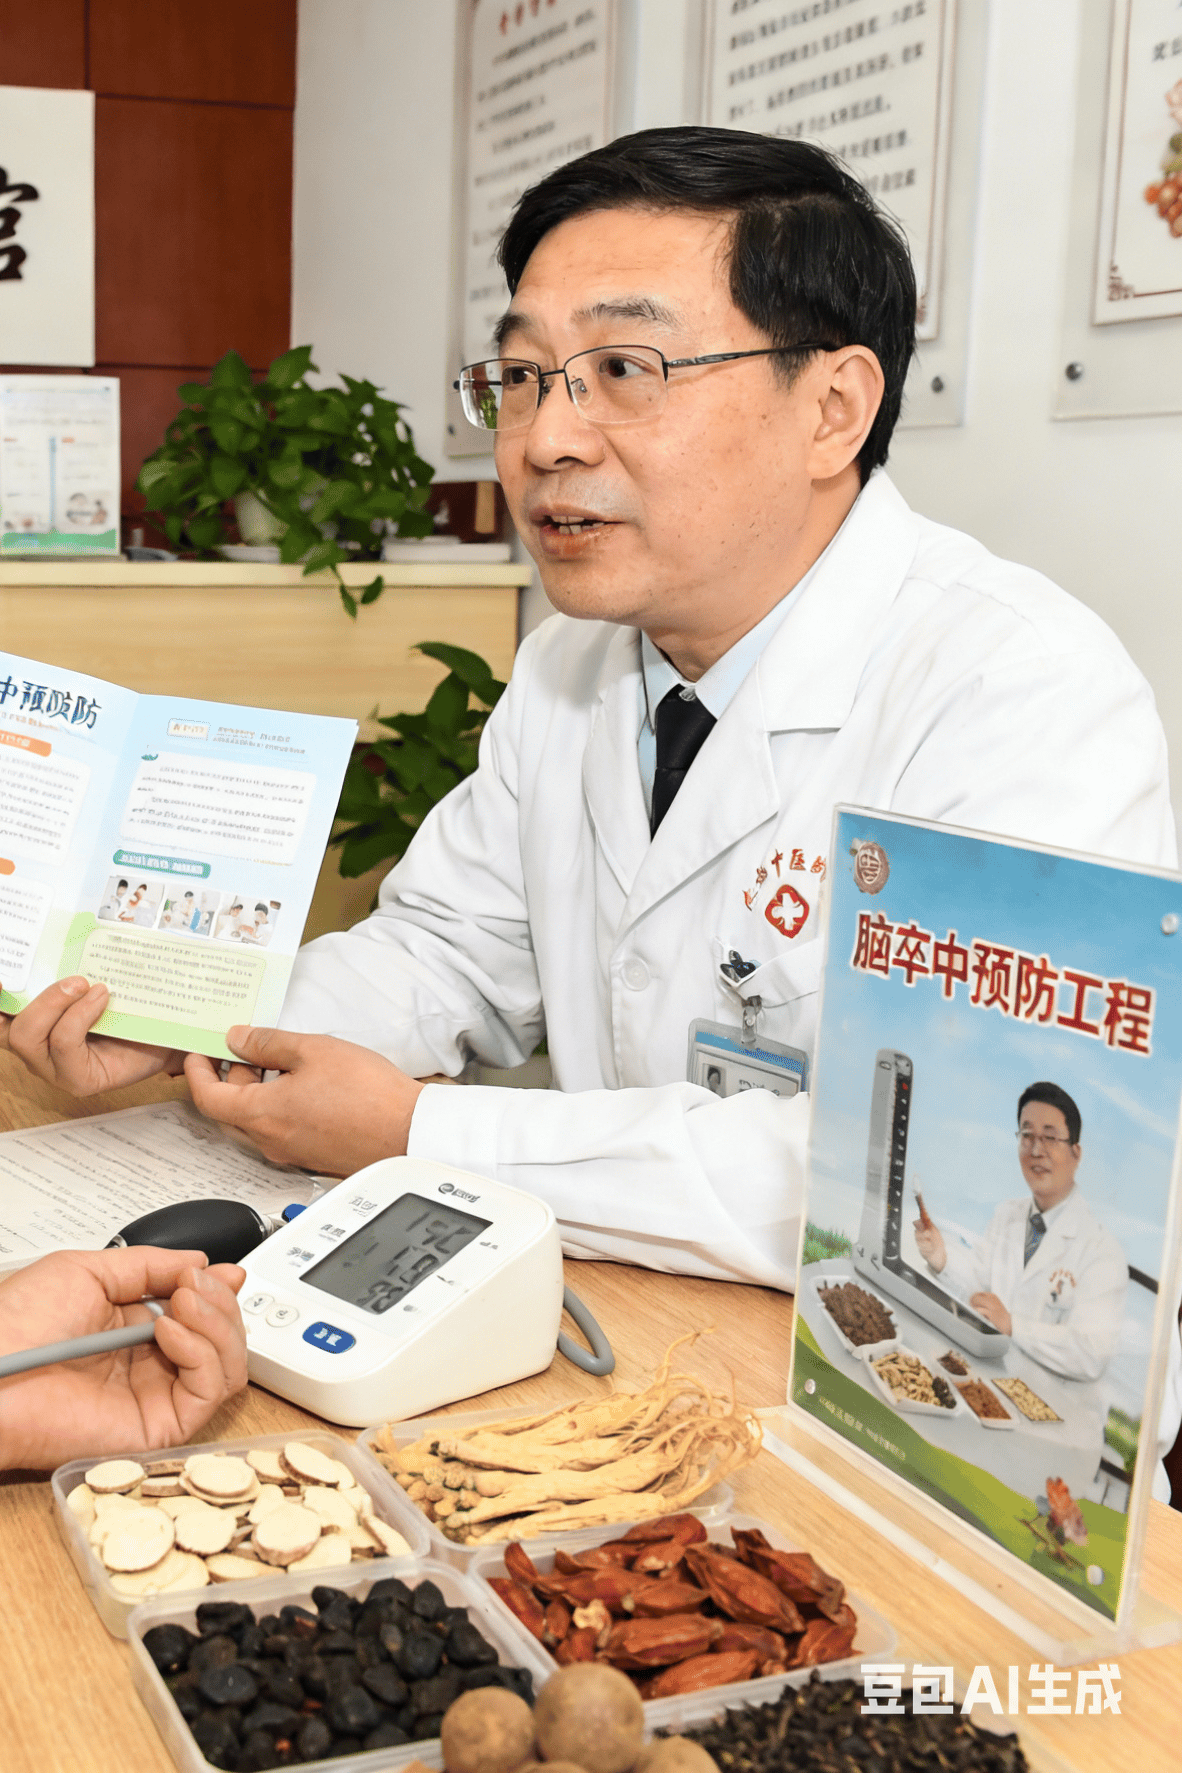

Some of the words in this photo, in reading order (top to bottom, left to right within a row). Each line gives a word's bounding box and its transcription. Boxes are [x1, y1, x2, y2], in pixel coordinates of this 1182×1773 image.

[852, 912, 1153, 1055] 脑卒中预防工程
